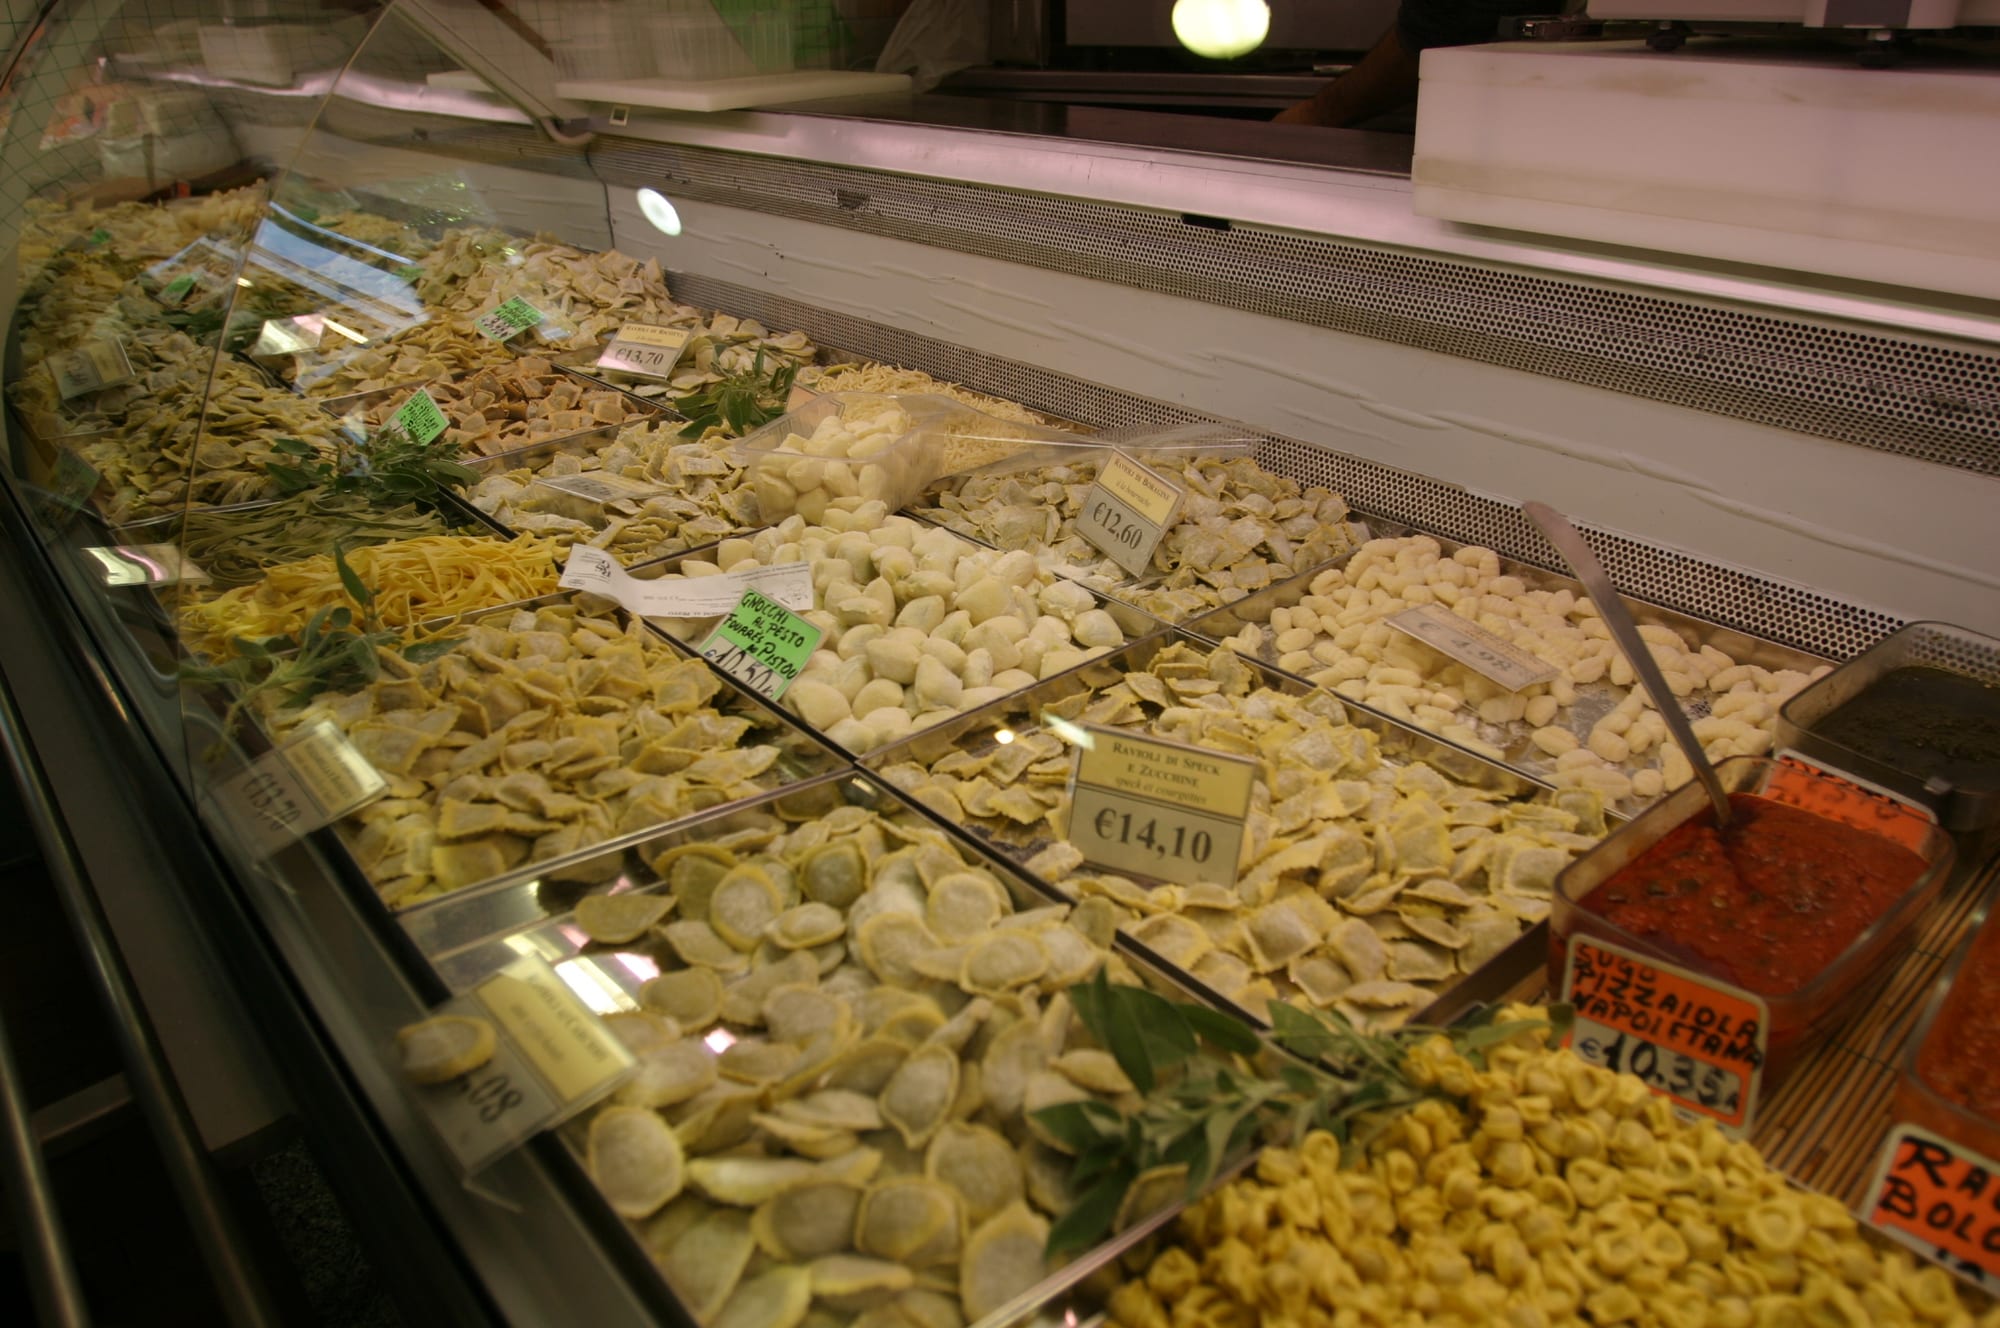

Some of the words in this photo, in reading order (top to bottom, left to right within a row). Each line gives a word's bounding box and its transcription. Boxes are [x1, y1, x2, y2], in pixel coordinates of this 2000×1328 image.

[615, 347, 665, 366] €13,70
[1093, 501, 1143, 550] €12,60
[740, 591, 789, 625] GNOCCHI
[752, 616, 766, 630] AL
[766, 622, 805, 649] PESTO
[757, 641, 799, 681] PISTOU
[1113, 742, 1160, 762] RAVIOLI
[1165, 755, 1179, 766] DI
[1183, 757, 1220, 776] SPECK
[1128, 763, 1135, 774] E
[1140, 765, 1199, 787] ZUCCHINE
[1095, 808, 1212, 863] €14,10
[1573, 958, 1761, 1042] PIZZAIOLA
[1898, 1135, 2000, 1213] RA
